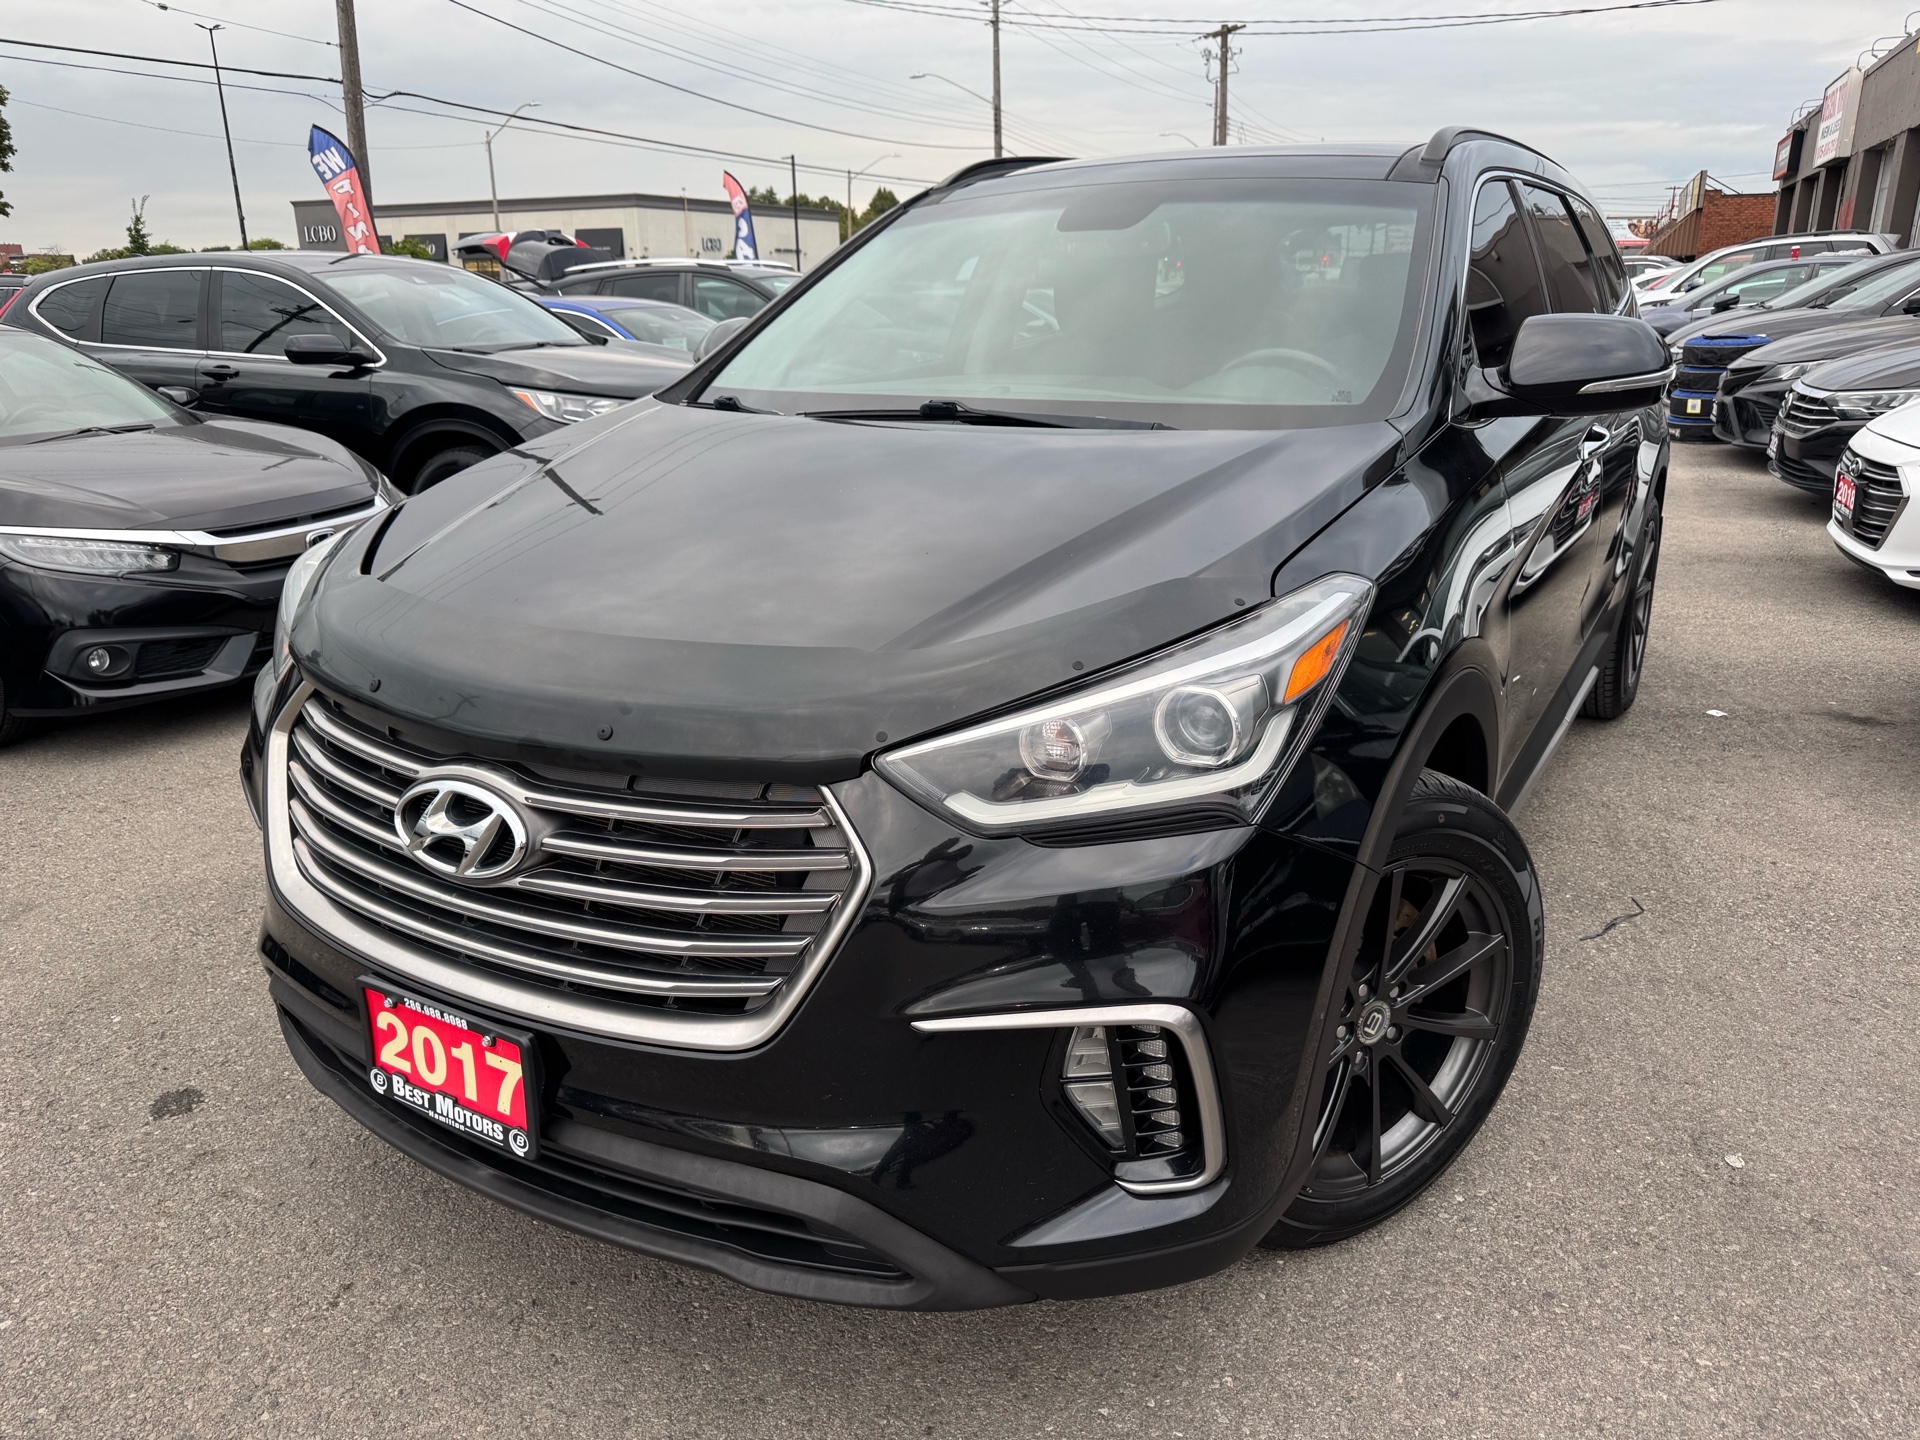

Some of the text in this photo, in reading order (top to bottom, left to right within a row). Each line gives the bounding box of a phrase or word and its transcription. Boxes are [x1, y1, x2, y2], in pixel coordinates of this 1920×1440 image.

[304, 225, 336, 242] LCBO
[1836, 481, 1856, 511] 2018
[403, 997, 468, 1030] 289.988.8088
[376, 1010, 523, 1116] 2017
[392, 1074, 504, 1141] BEST MOTORS
[428, 1109, 467, 1132] Hamilton
